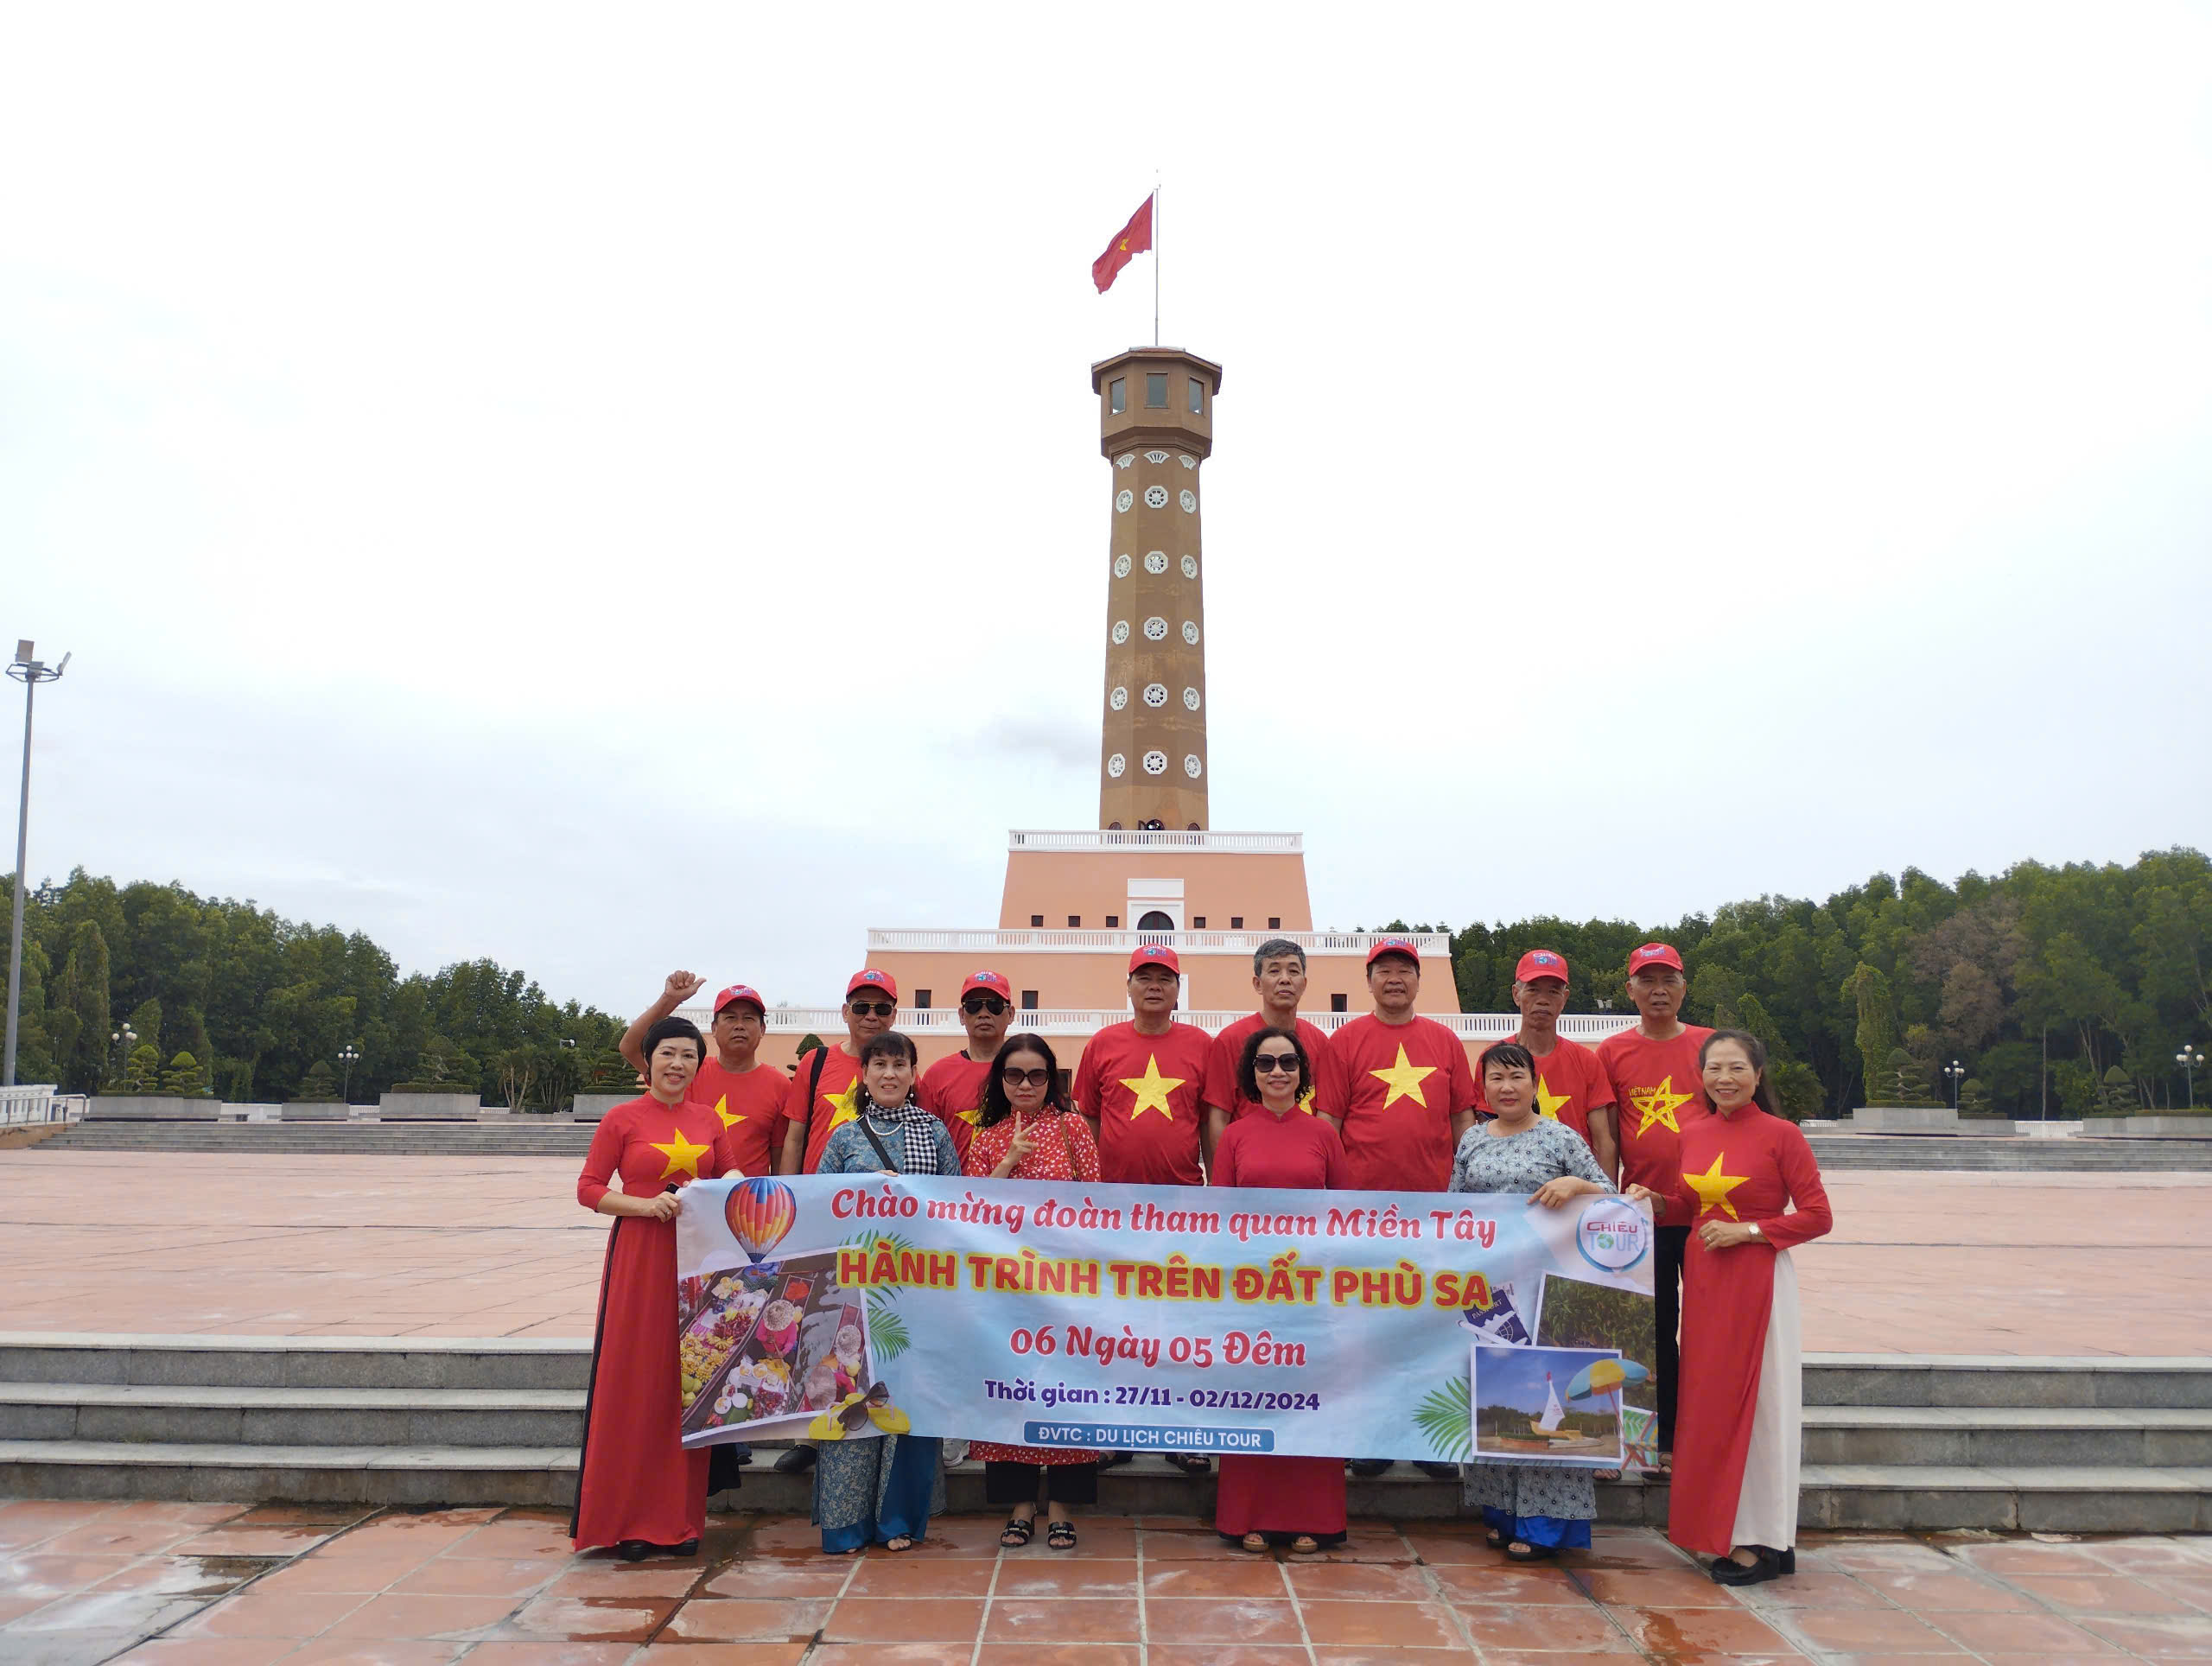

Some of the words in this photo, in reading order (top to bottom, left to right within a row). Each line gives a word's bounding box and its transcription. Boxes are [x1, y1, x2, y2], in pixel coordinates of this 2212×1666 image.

[831, 1184, 919, 1219] Chào
[927, 1191, 1026, 1234] mừng
[1033, 1196, 1122, 1230] đoàn
[1130, 1202, 1220, 1235] tham
[1229, 1211, 1318, 1243] quan
[1325, 1203, 1422, 1240] Miền
[1429, 1209, 1497, 1249] Tây
[841, 1241, 956, 1288] HÀNH
[968, 1250, 1098, 1294] TRÌNH
[1109, 1255, 1220, 1299] TRÊN
[1232, 1251, 1322, 1301] ĐẤT
[1333, 1262, 1422, 1306] PHÙ
[1434, 1274, 1490, 1307] SA
[1009, 1325, 1057, 1356] 06
[1065, 1325, 1161, 1368] Ngày
[1168, 1336, 1214, 1369] 05
[1222, 1329, 1307, 1367] Đêm
[984, 1377, 1036, 1402] Thời
[1041, 1382, 1098, 1408] gian
[1115, 1386, 1172, 1407] 27/11
[1189, 1389, 1320, 1411] 02/12/2024
[1038, 1427, 1083, 1441] ĐVTC
[1096, 1428, 1118, 1443] DU
[1122, 1429, 1159, 1447] LỊCH
[1164, 1428, 1214, 1446] CHIÊU
[1218, 1432, 1262, 1447] TOUR
